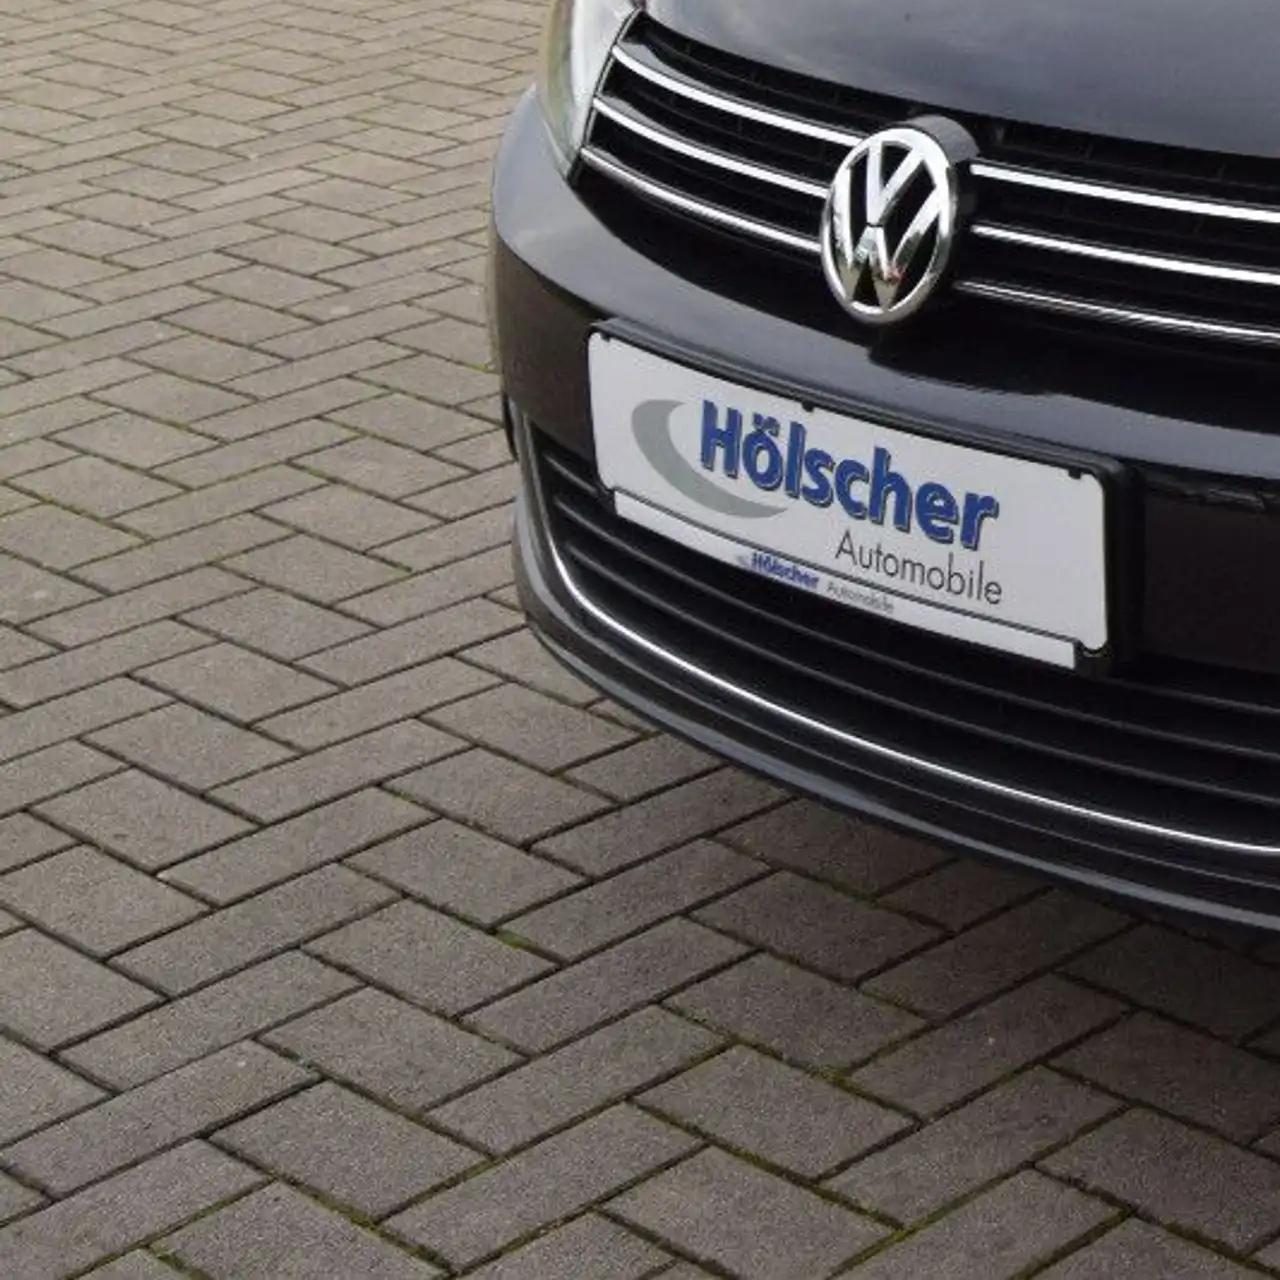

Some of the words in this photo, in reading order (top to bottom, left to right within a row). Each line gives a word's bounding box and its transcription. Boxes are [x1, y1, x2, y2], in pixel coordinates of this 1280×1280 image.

[700, 399, 1000, 551] Hölscher
[751, 550, 820, 589] Hölscher
[835, 528, 1003, 605] Automobile
